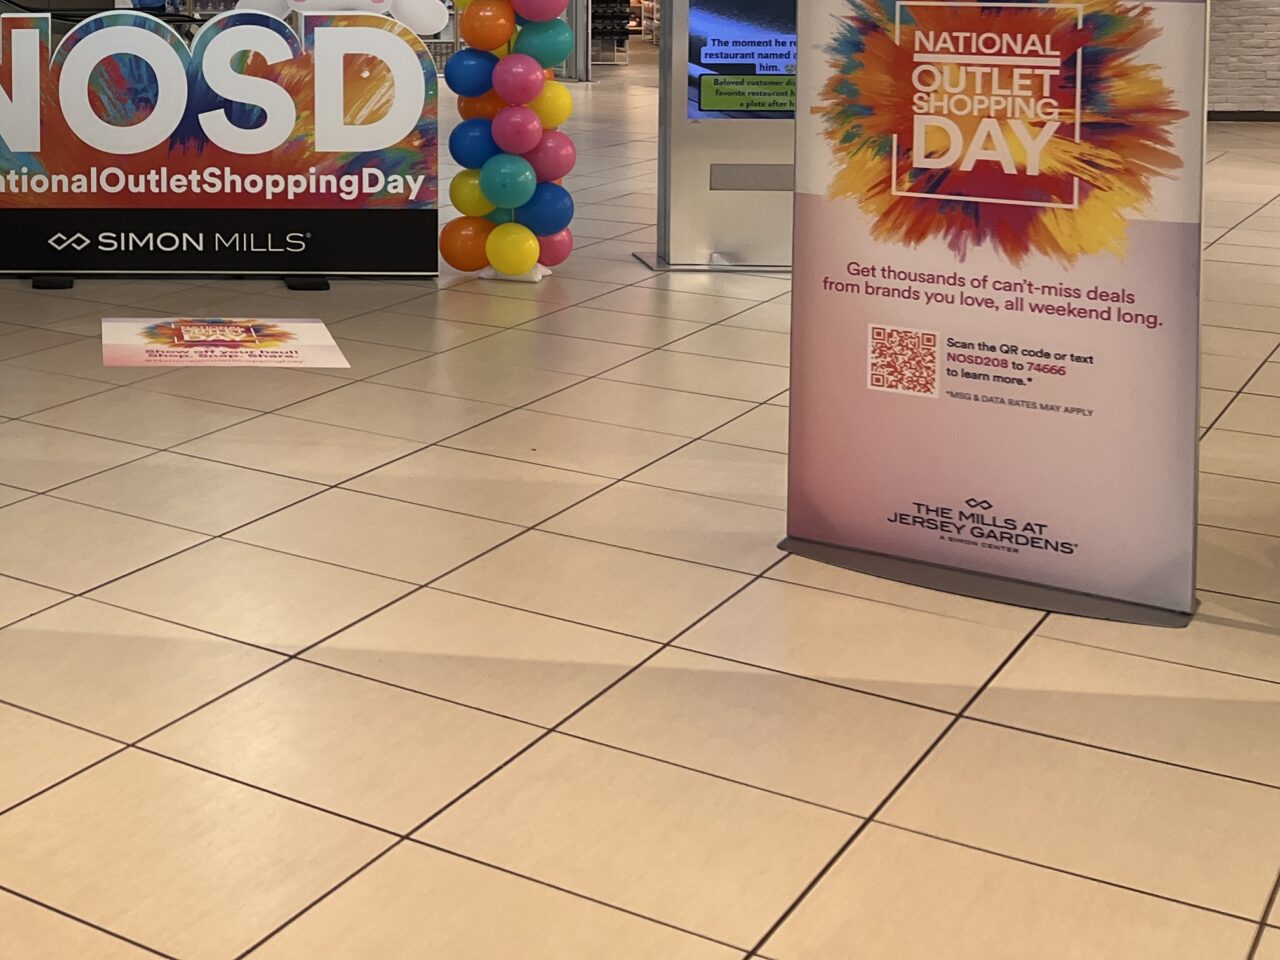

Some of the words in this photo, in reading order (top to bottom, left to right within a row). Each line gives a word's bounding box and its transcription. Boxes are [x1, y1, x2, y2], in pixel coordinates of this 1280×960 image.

[704, 51, 755, 59] restaurant
[757, 51, 790, 59] named
[711, 38, 729, 47] The
[732, 39, 772, 47] moment
[774, 38, 786, 47] he
[913, 30, 1060, 56] NATIONAL
[759, 63, 781, 71] him.
[912, 64, 1060, 97] OUTLET
[912, 94, 1060, 120] SHOPPING
[912, 115, 1062, 177] DAY
[98, 231, 204, 252] SIMON
[846, 261, 877, 279] Get
[880, 265, 966, 288] thousands
[970, 273, 988, 290] of
[1086, 284, 1136, 305] deals
[822, 277, 860, 294] from
[864, 281, 920, 302] brands
[924, 289, 956, 306] you
[959, 291, 1000, 312] love,
[1004, 296, 1024, 312] all
[1029, 298, 1111, 322] weekend
[1116, 306, 1163, 329] long.
[946, 337, 974, 351] Scan
[977, 340, 996, 353] the
[999, 342, 1018, 357] QR
[1021, 346, 1051, 360] code
[1054, 351, 1067, 361] or
[1069, 353, 1094, 365] text
[946, 352, 1009, 369] NOSD208
[1011, 359, 1024, 370] to
[1026, 360, 1067, 376] 74666
[946, 366, 957, 377] to
[961, 368, 990, 382] learn
[981, 395, 1006, 406] DATA
[1008, 398, 1037, 410] RATES
[1039, 402, 1061, 413] MAY
[1063, 406, 1094, 417] APPLY
[886, 512, 965, 535] JERSEY
[912, 501, 953, 520] THE
[958, 510, 1017, 531] MILLS
[1021, 522, 1048, 537] AT
